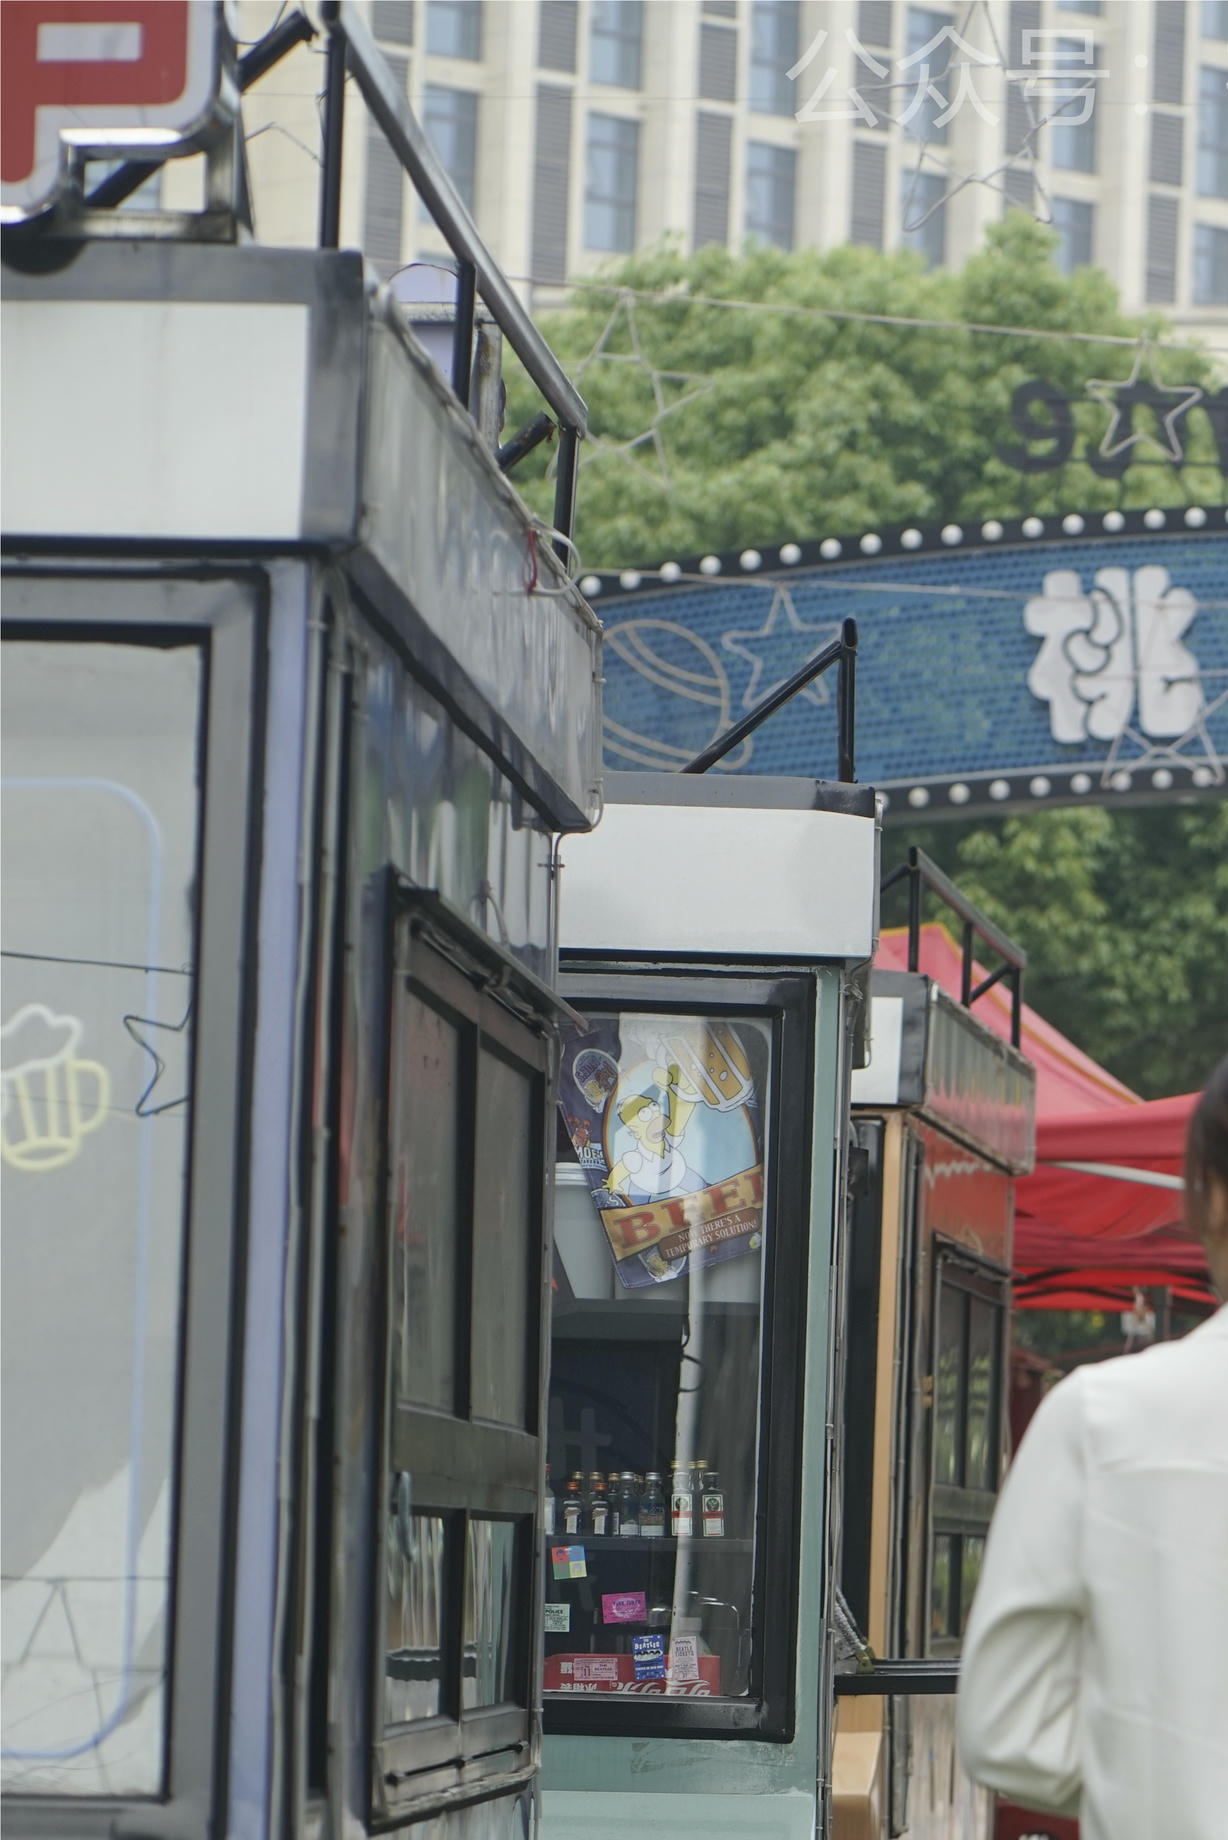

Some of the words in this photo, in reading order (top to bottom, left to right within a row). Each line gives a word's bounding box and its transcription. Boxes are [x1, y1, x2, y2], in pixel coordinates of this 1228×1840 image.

[612, 1172, 764, 1249] BEE
[702, 1217, 732, 1234] THERE'S
[735, 1214, 742, 1223] A
